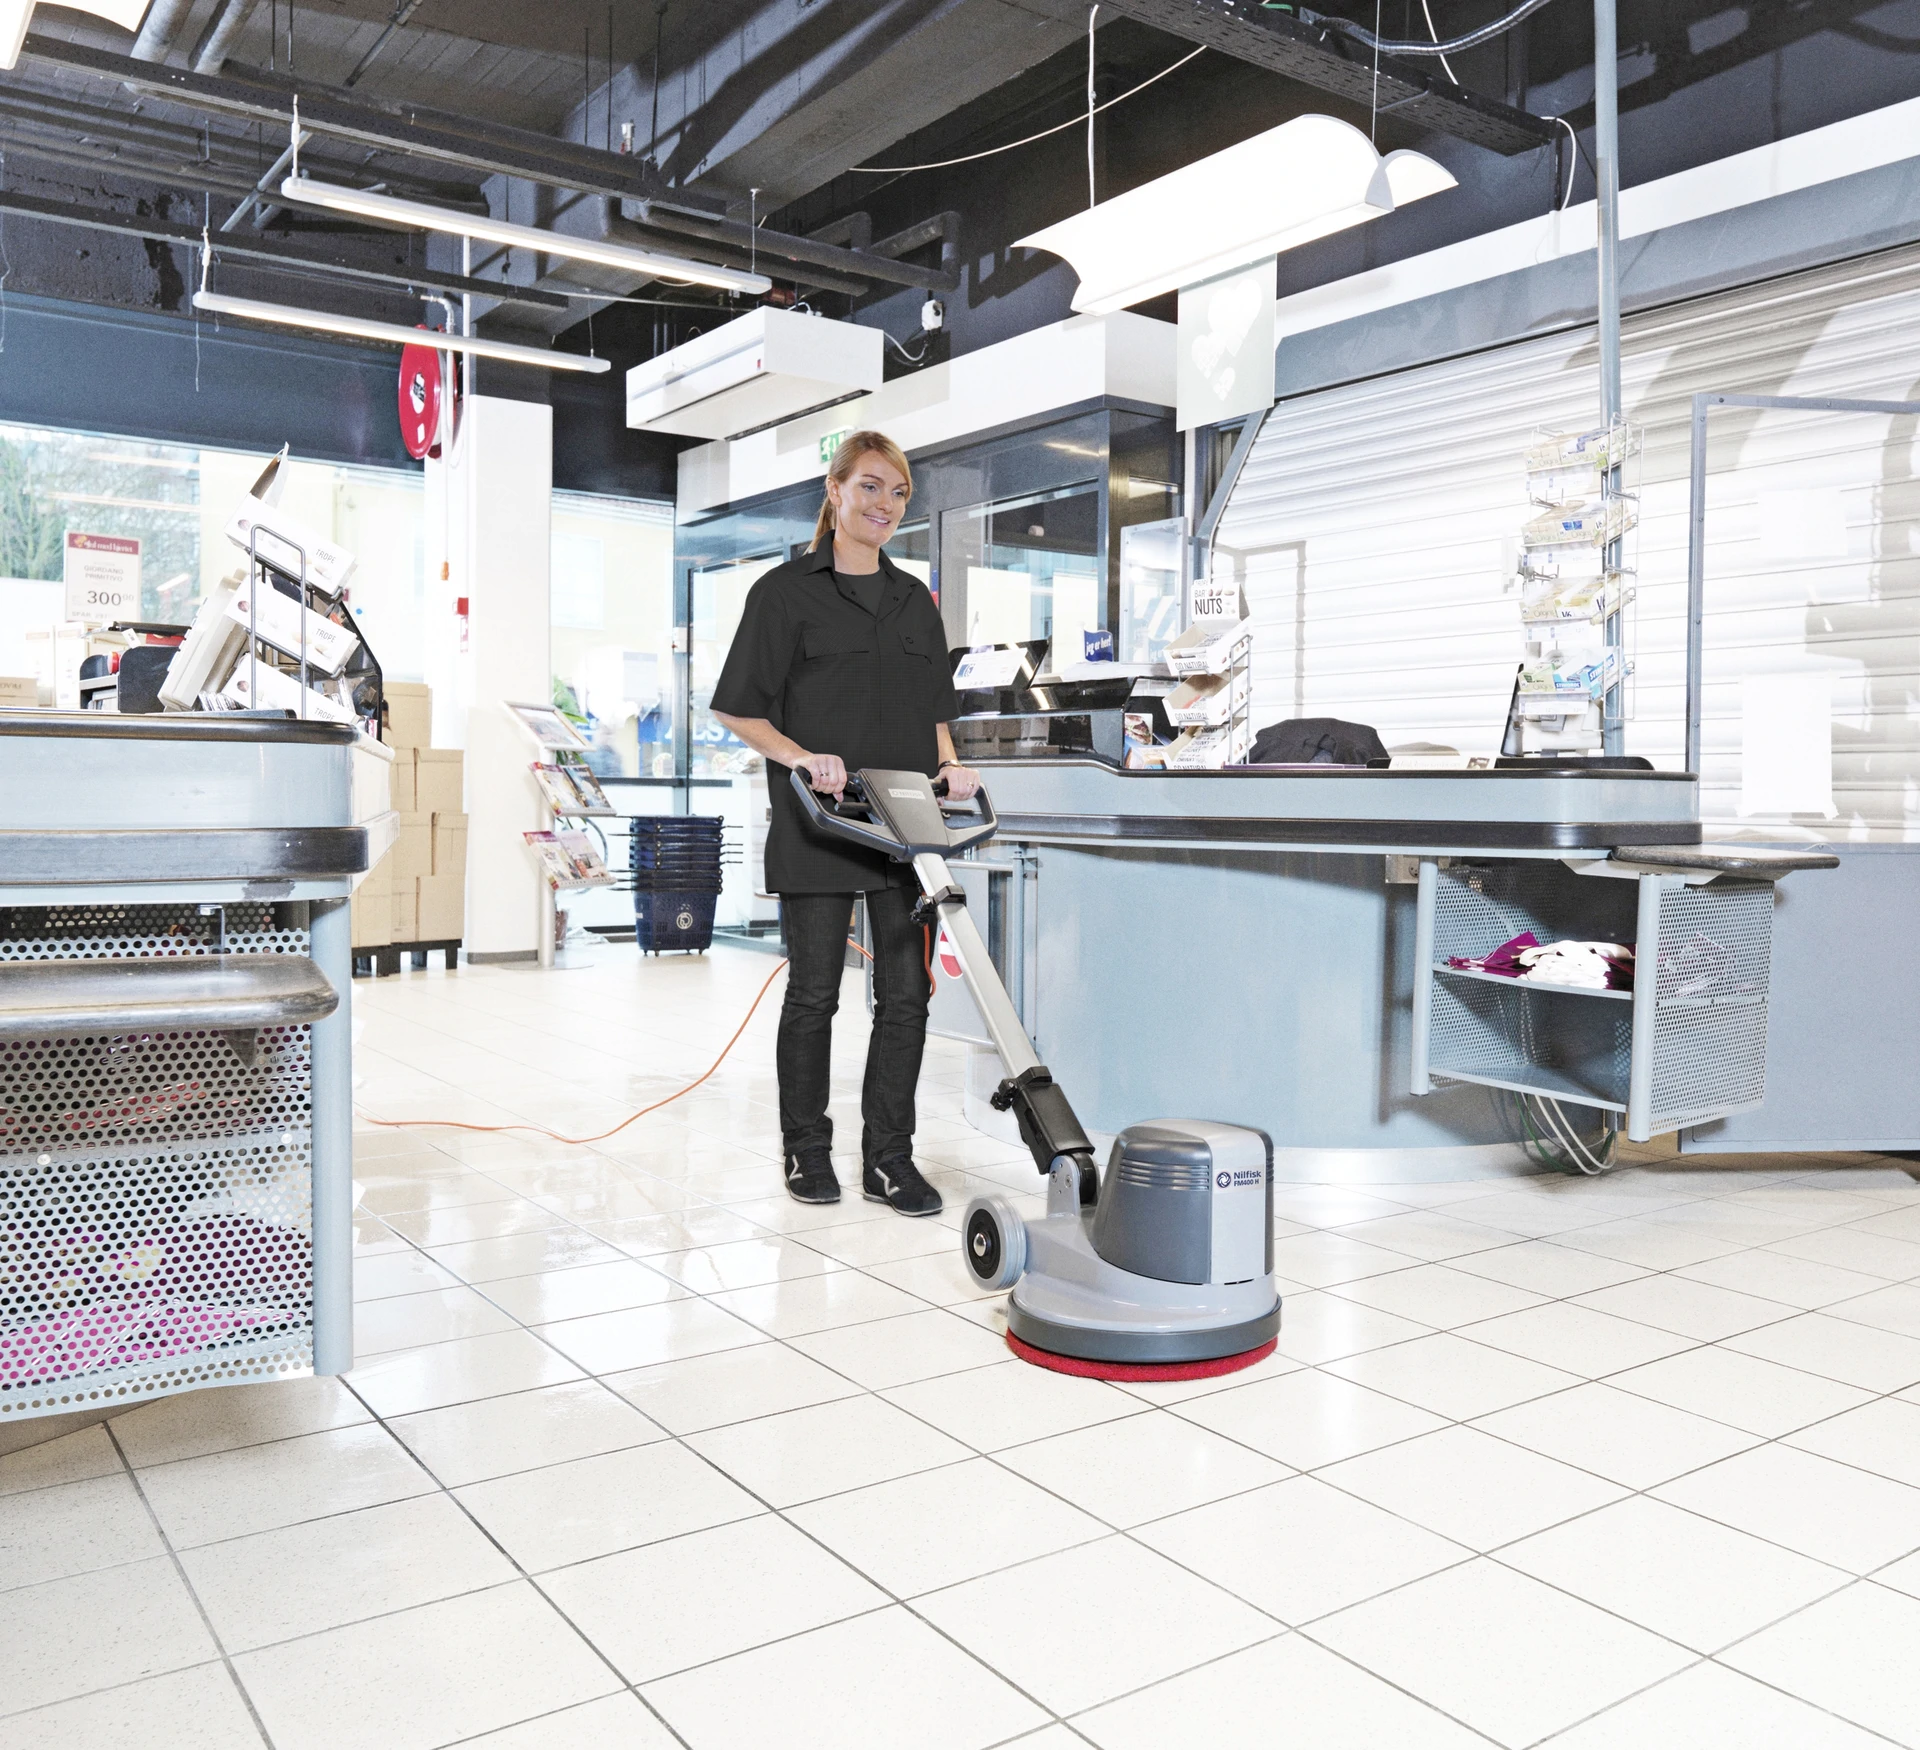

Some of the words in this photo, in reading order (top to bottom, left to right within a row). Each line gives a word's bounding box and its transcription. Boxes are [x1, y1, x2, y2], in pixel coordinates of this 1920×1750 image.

[87, 590, 122, 606] 300
[1194, 598, 1223, 615] NUTS
[315, 628, 337, 643] TROPE
[1233, 1170, 1262, 1179] Nilfisk
[1233, 1179, 1254, 1187] FM400
